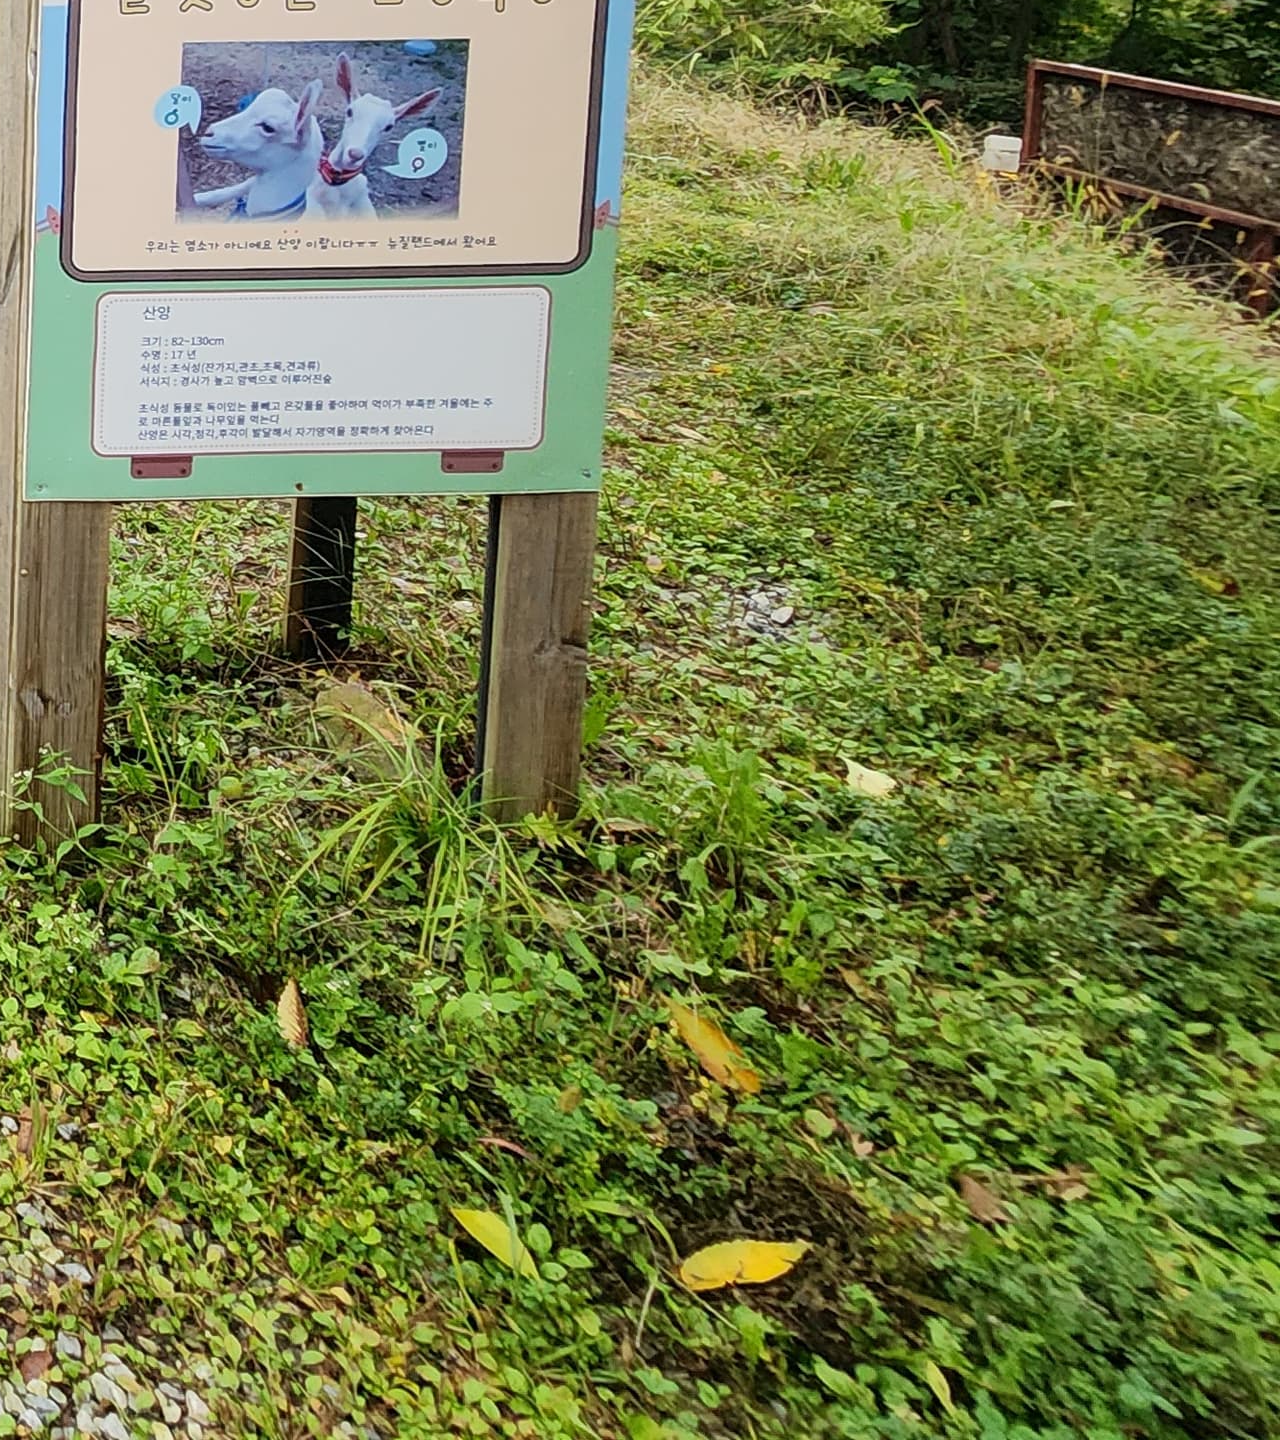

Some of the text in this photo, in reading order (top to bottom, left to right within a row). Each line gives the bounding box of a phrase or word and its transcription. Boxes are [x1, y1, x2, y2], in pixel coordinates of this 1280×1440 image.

[145, 240, 181, 253] 우리는
[184, 240, 220, 252] 염소가
[224, 239, 273, 250] 아니에요
[277, 238, 301, 250] 산양
[387, 235, 458, 250] 뉴질랜드에서
[462, 235, 497, 249] 왔어요
[143, 305, 171, 320] 산양
[141, 336, 162, 347] 크기
[141, 350, 161, 360] 수명
[171, 350, 183, 360] 17
[187, 349, 197, 360] 년
[140, 363, 161, 375] 식성
[140, 376, 171, 387] 서식지
[181, 376, 210, 387] 경사가
[214, 376, 233, 386] 높고
[138, 402, 169, 414] 초식성
[173, 402, 203, 413] 동물로
[372, 399, 401, 409] 먹이가
[405, 398, 436, 409] 부족한
[440, 398, 479, 409] 겨울에는
[139, 416, 148, 426] 로
[249, 414, 279, 425] 먹는다
[138, 429, 169, 440] 산양은
[252, 427, 291, 438] 발달해서
[295, 425, 345, 438] 자기영역을
[350, 425, 390, 437] 정확하게
[394, 425, 434, 436] 찾아온다
